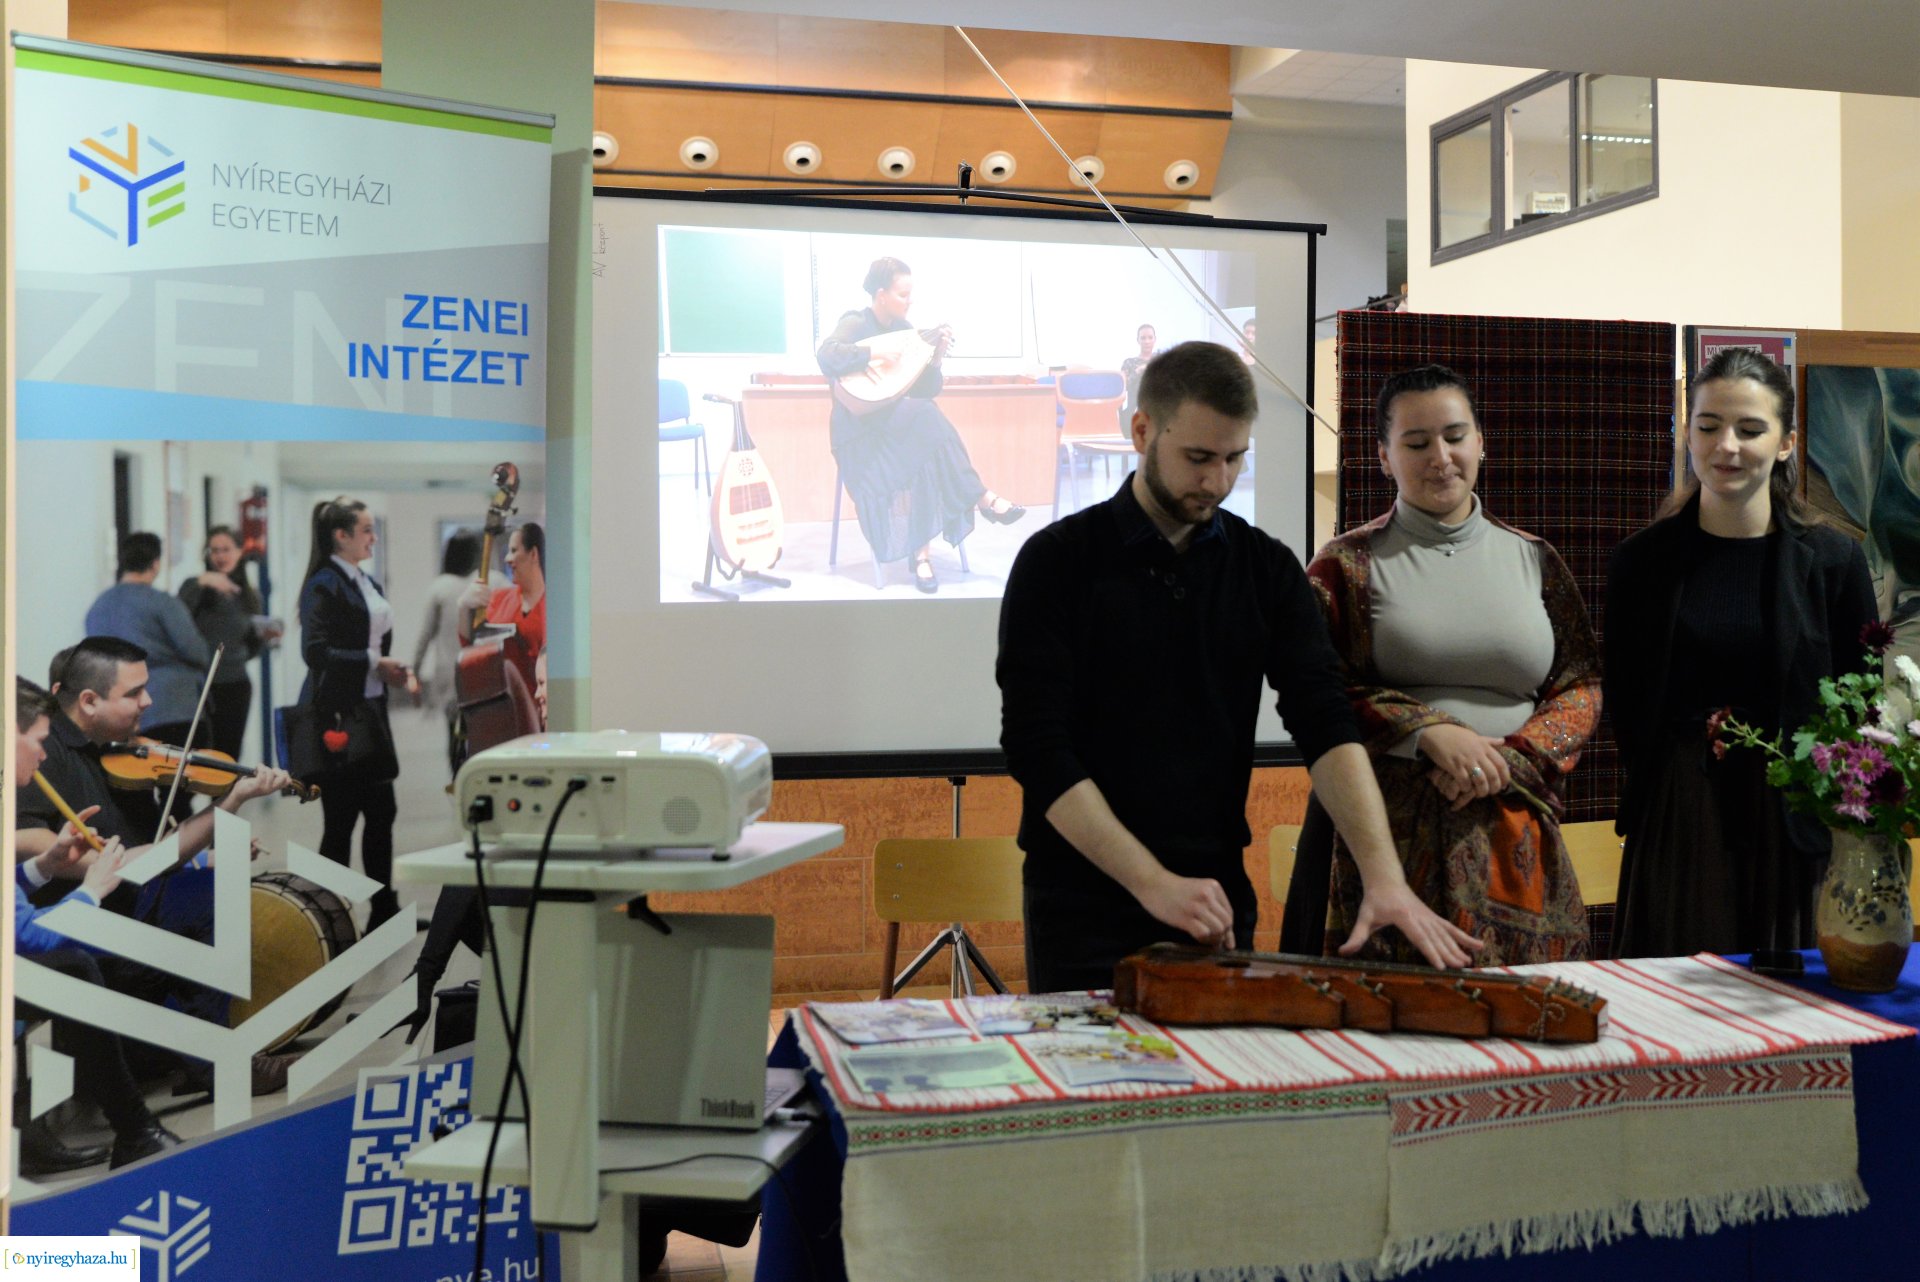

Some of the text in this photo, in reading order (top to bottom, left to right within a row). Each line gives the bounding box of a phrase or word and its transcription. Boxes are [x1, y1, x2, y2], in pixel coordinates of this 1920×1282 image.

[212, 161, 391, 206] NYÍREGYHÁZI
[212, 203, 339, 238] EGYETEM
[402, 293, 529, 337] ZENEI
[347, 337, 530, 387] INTÉZET
[701, 1098, 756, 1119] ThinkBook
